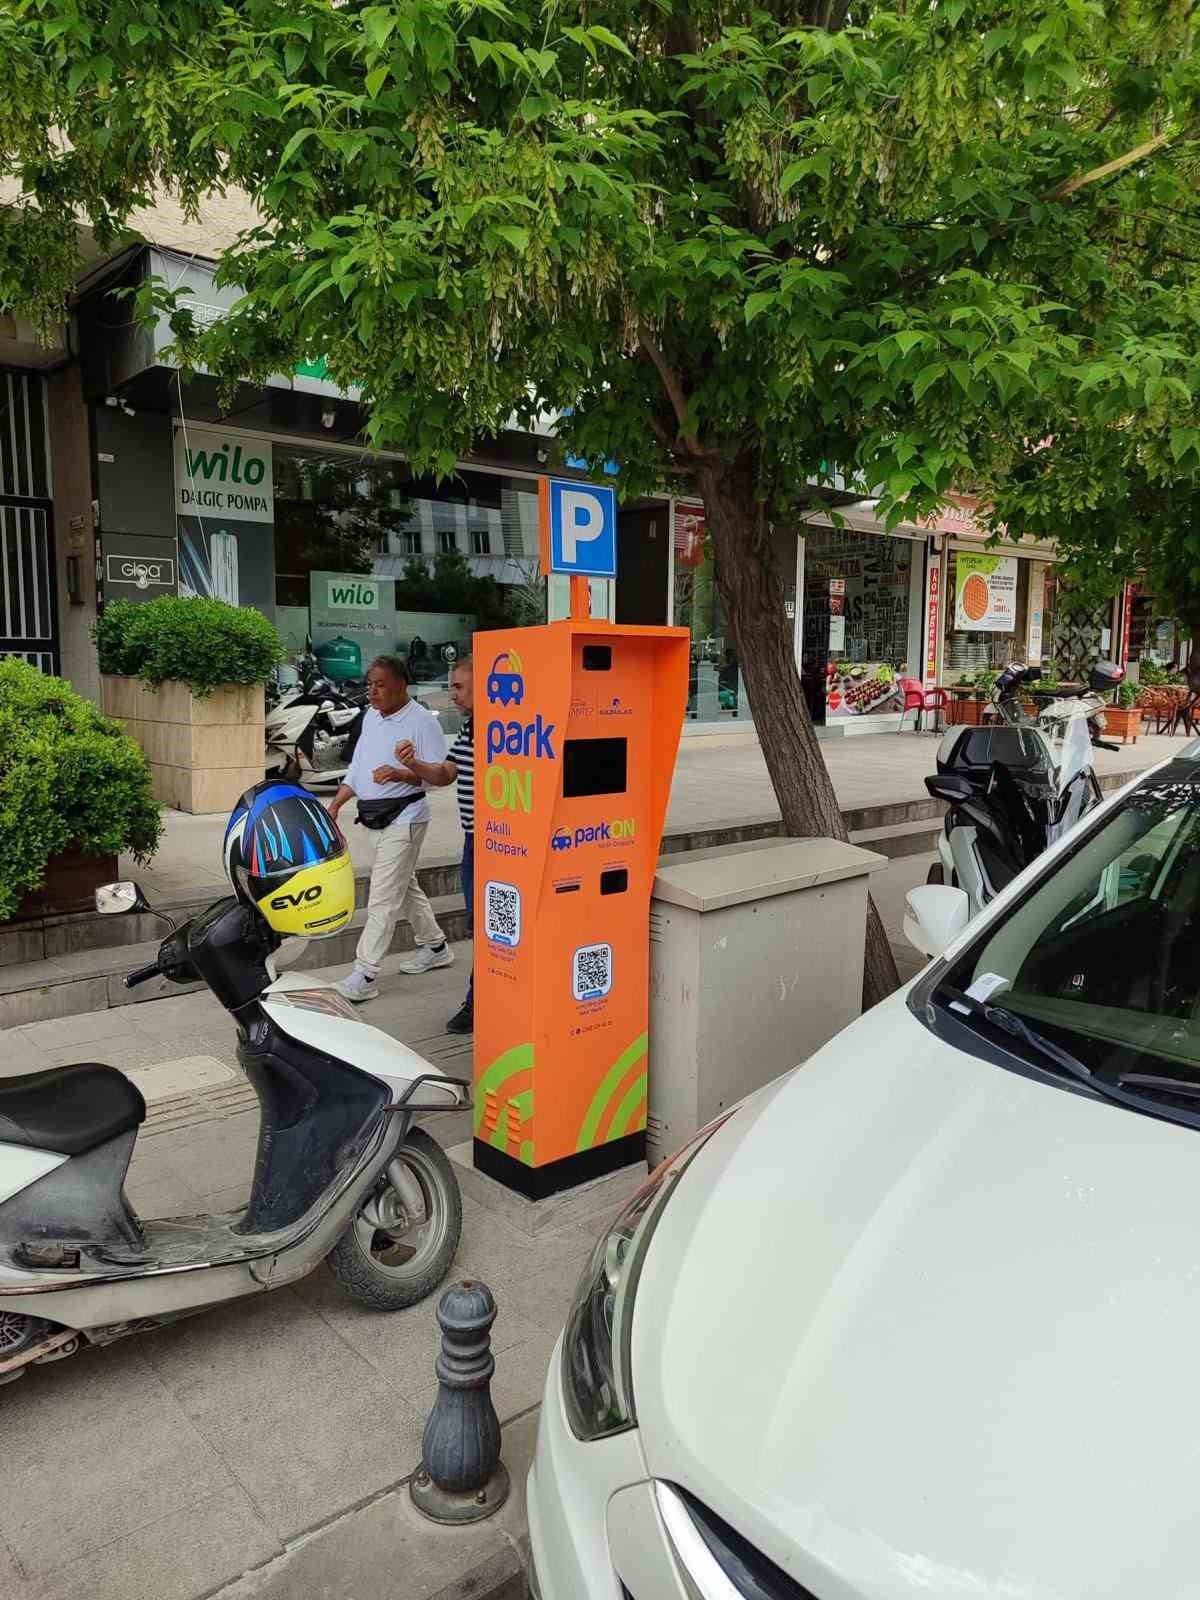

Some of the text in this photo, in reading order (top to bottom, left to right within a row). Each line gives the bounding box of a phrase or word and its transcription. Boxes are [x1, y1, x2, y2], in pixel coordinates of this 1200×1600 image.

[184, 443, 265, 486] wilo
[181, 488, 268, 513] DALGIÇ POMPA
[560, 489, 605, 564] P
[331, 583, 375, 605] wilo
[487, 714, 556, 764] park
[484, 765, 534, 814] ON
[485, 820, 512, 836] Akıllı
[485, 840, 529, 857] Otopark
[270, 885, 322, 911] EVO
